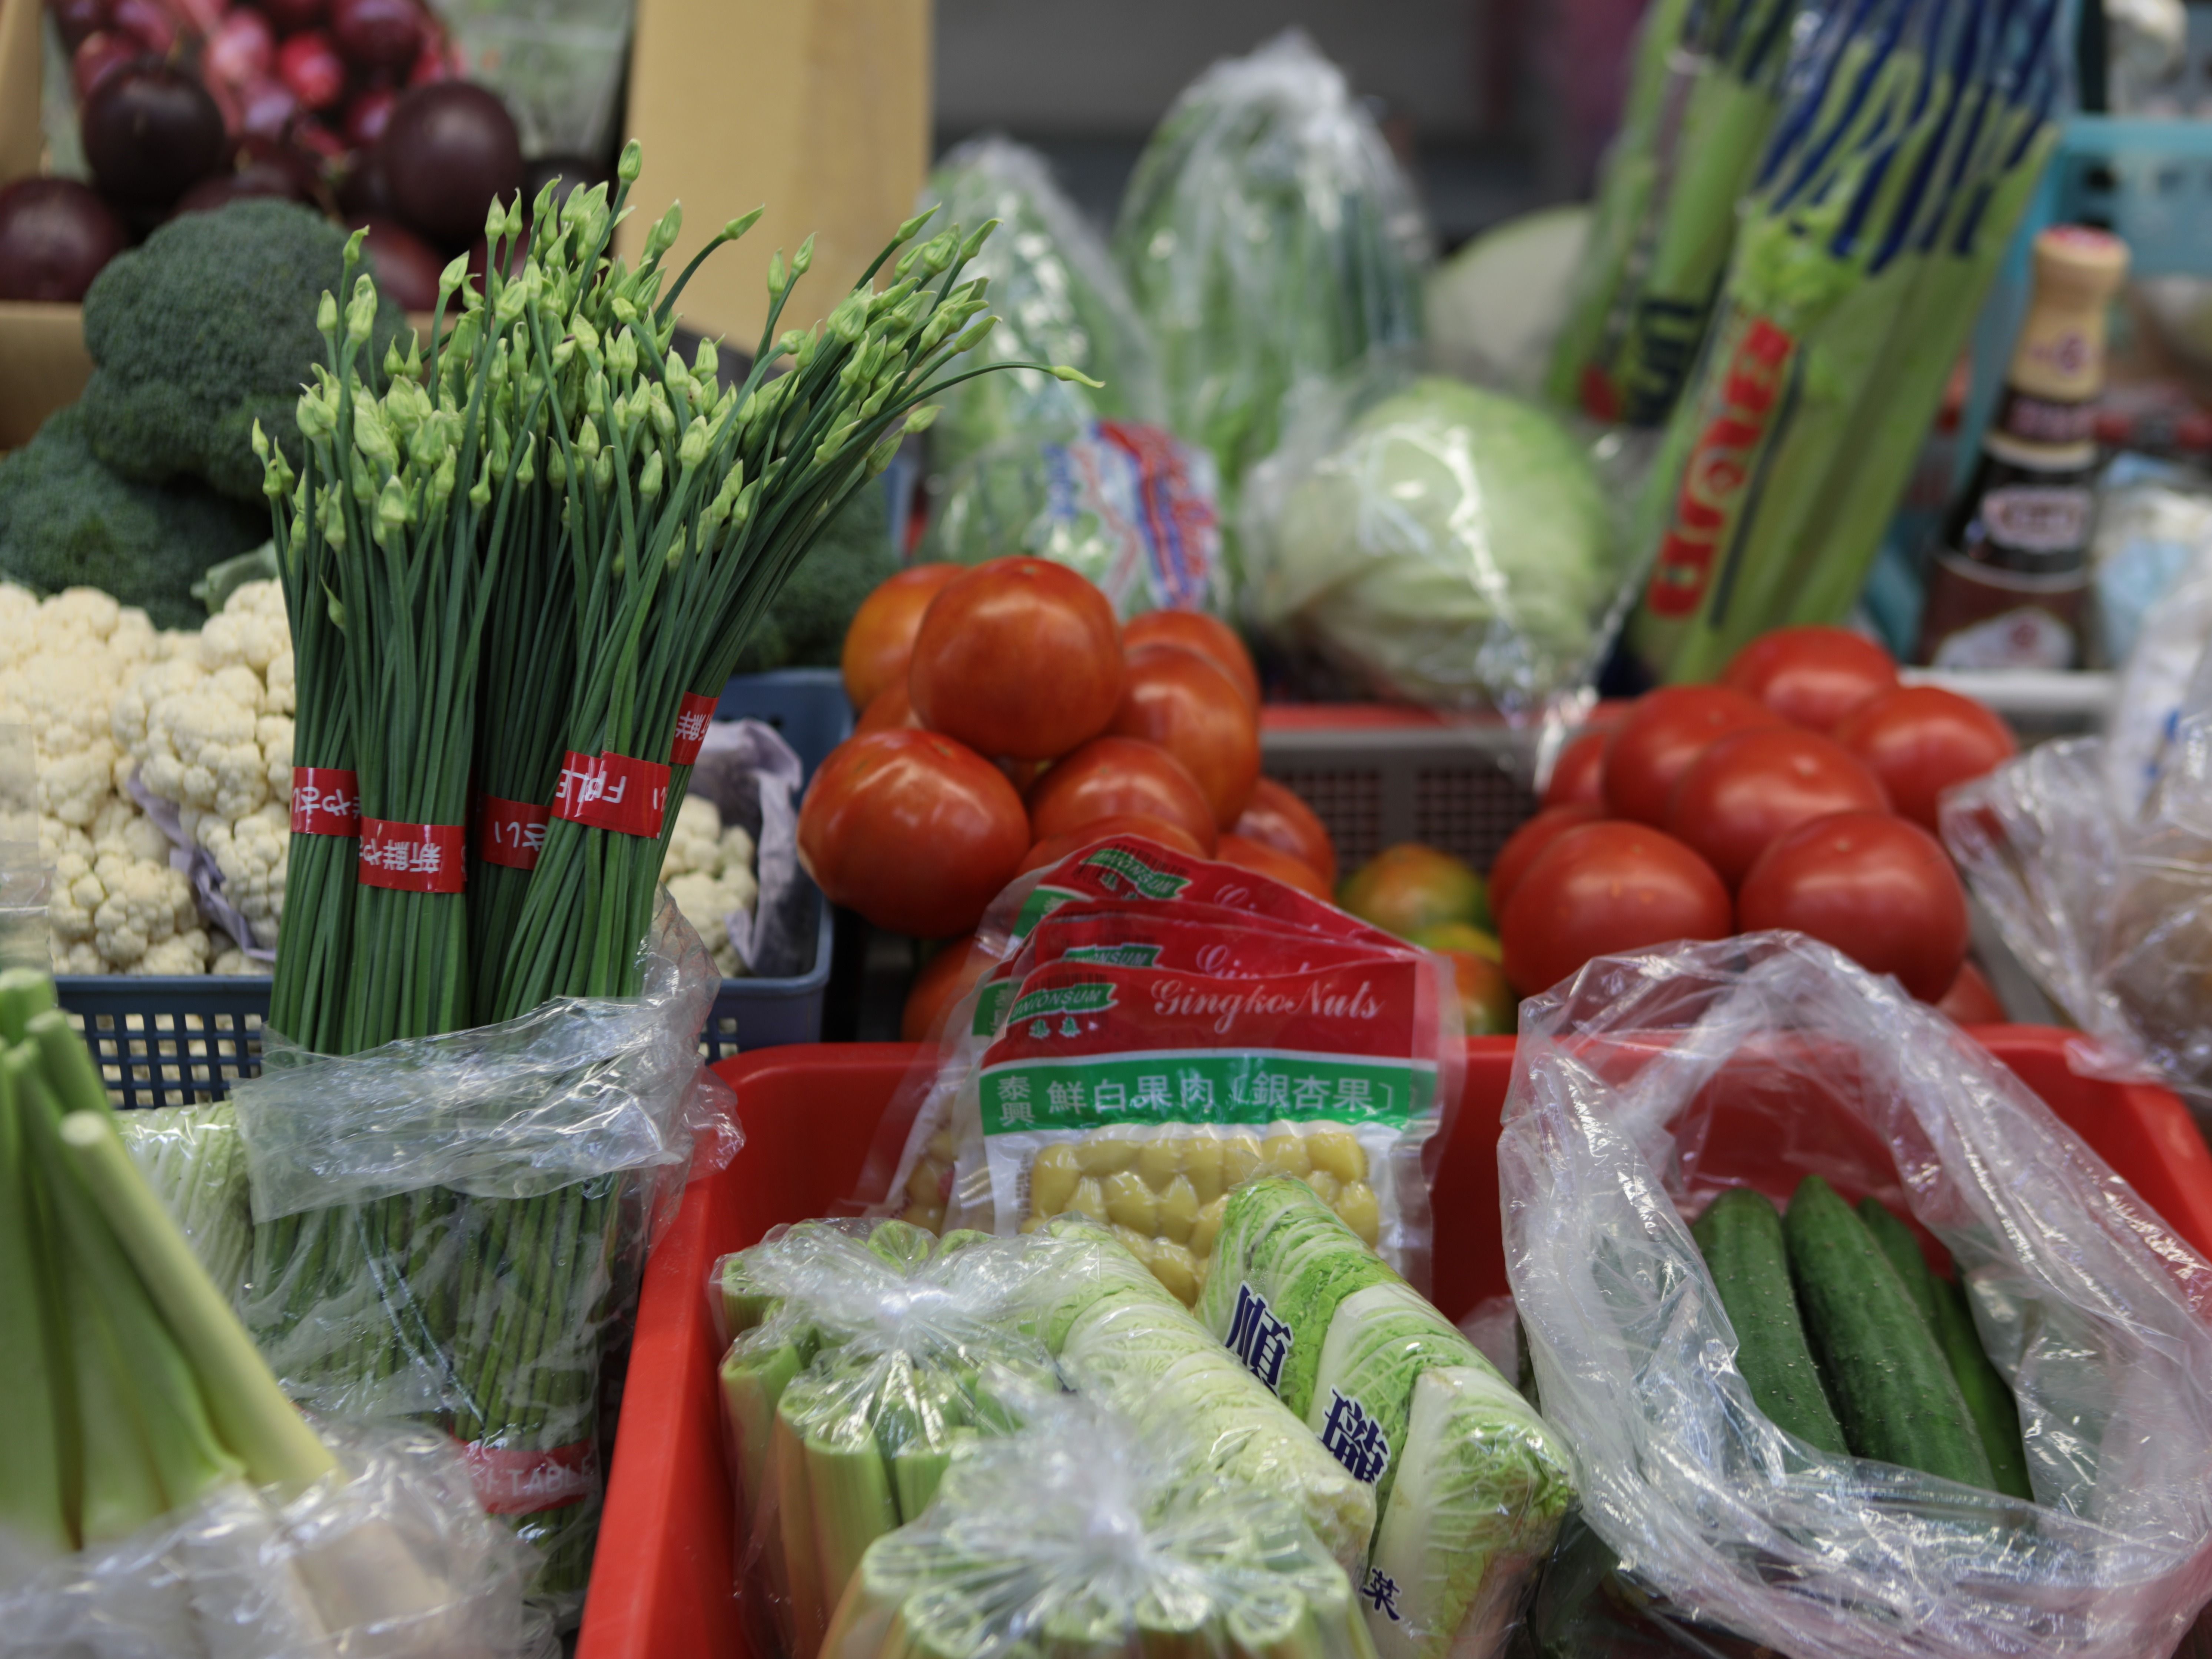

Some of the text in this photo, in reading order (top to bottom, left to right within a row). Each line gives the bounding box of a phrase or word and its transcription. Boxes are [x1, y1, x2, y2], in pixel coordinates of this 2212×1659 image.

[359, 835, 442, 874] 新鮮や
[1010, 990, 1102, 1018] UNIONSUM
[1151, 979, 1385, 1034] Gingko Nuts
[997, 1075, 1036, 1127] 泰興
[1363, 1568, 1400, 1620] 菜
